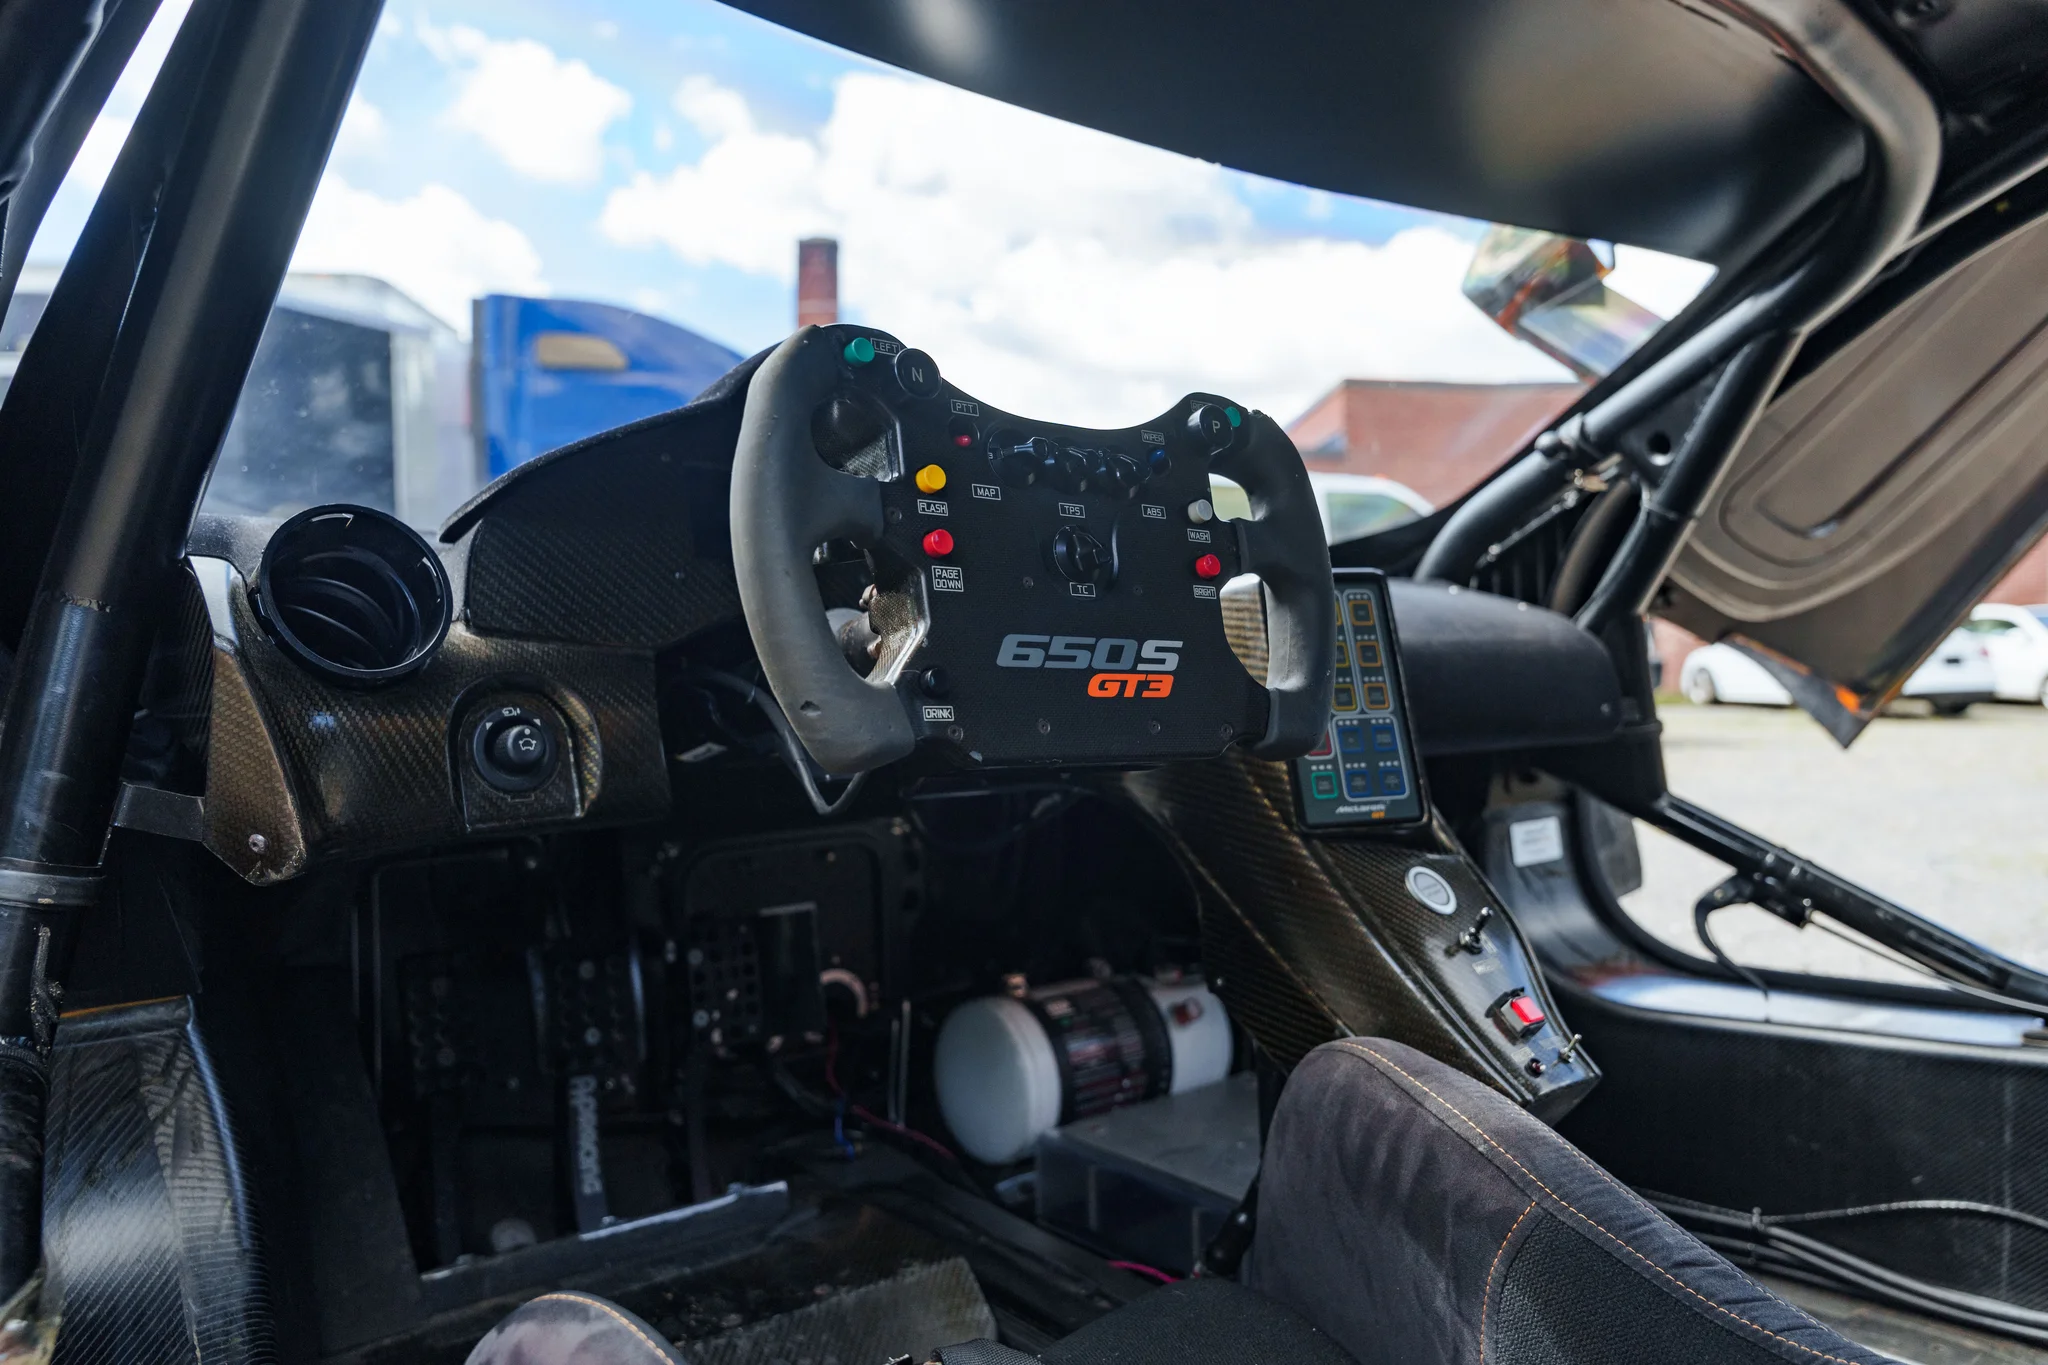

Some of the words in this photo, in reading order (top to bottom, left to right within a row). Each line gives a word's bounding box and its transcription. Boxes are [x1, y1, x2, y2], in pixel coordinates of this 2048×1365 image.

[873, 341, 898, 354] LEFT
[911, 366, 924, 383] N
[955, 402, 974, 414] PTT
[1212, 420, 1221, 434] P
[1142, 432, 1164, 443] WIPER
[976, 486, 996, 498] MAP
[919, 502, 947, 514] FLASH
[1063, 505, 1081, 516] TPS
[1146, 507, 1162, 517] ABS
[1189, 531, 1209, 542] WASH
[935, 568, 959, 579] PAGE
[935, 578, 961, 589] DOWN
[1076, 584, 1088, 595] TC
[1194, 587, 1215, 597] BRIGHT
[996, 634, 1183, 672] 650S
[1087, 673, 1175, 698] GT3
[925, 708, 952, 720] DRINK
